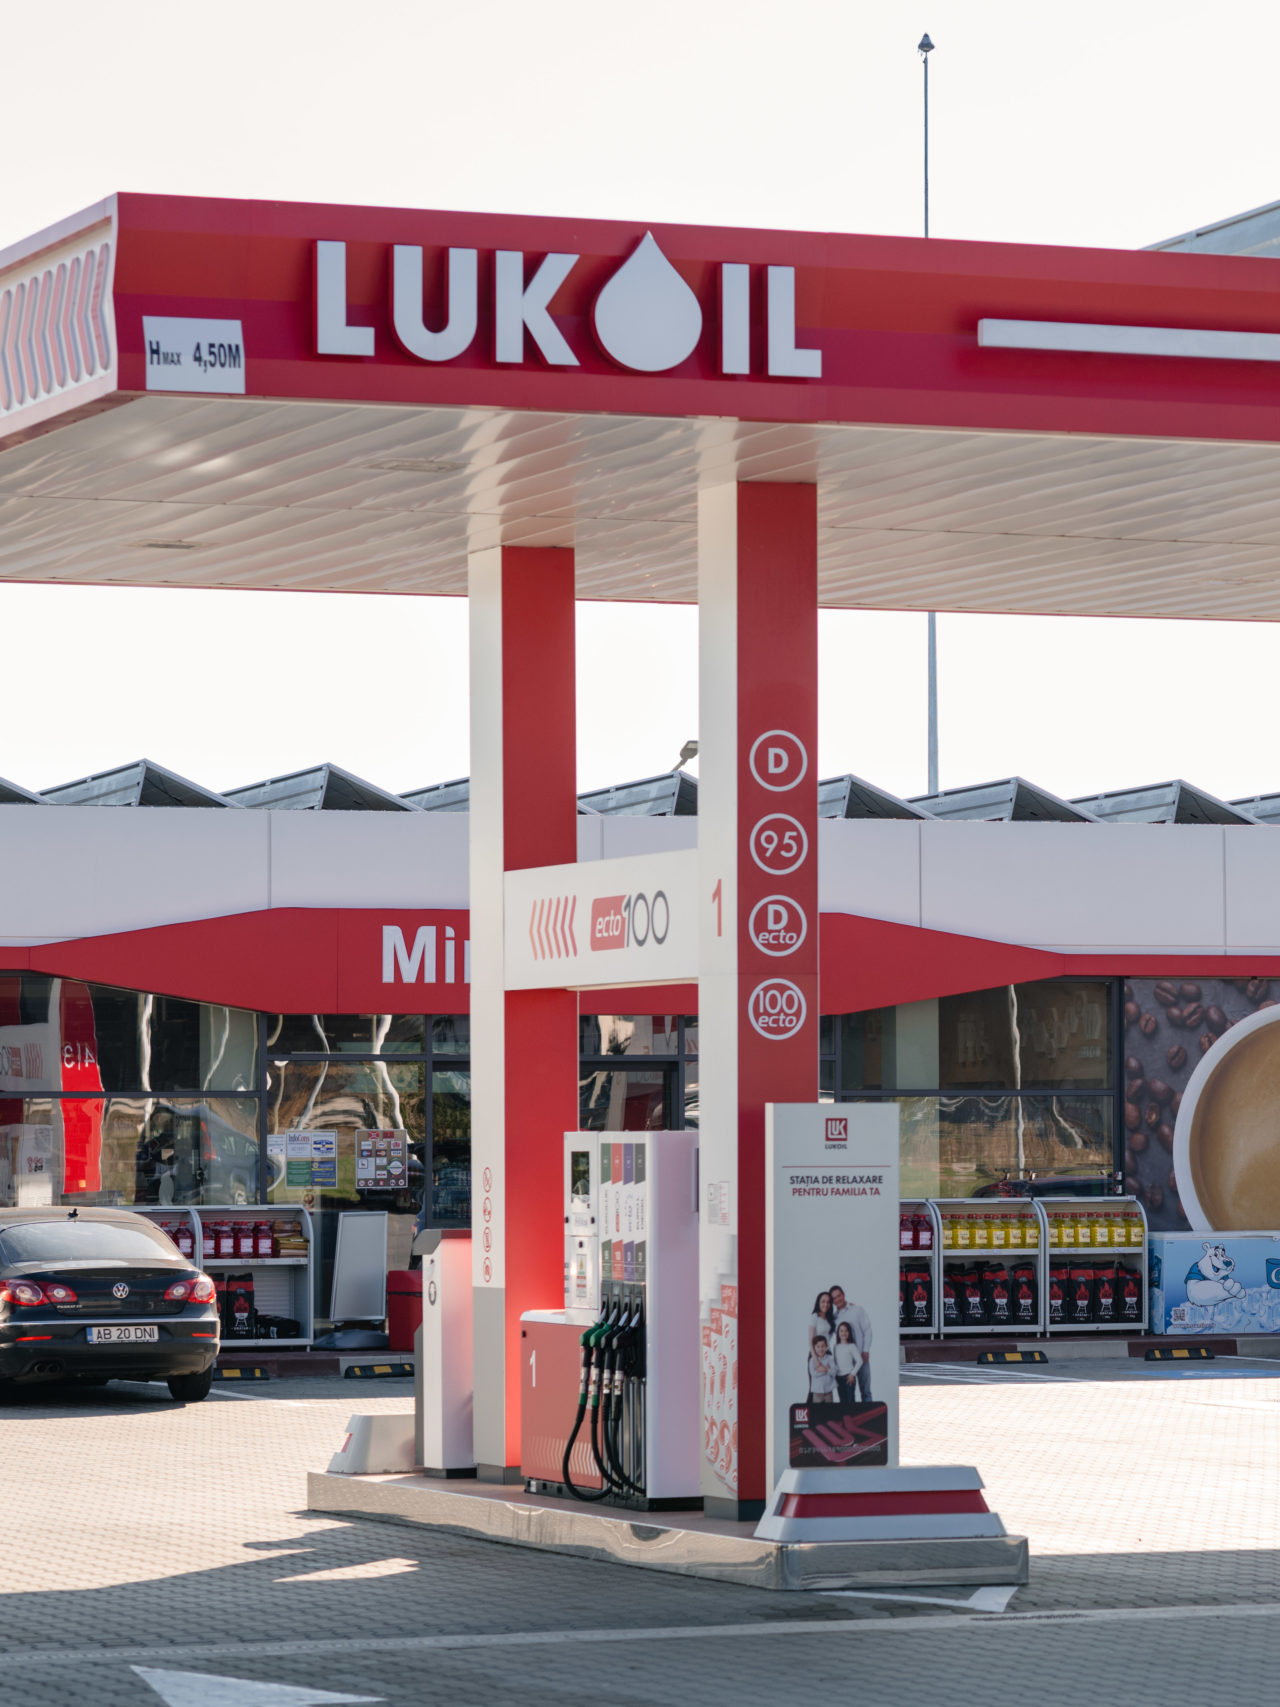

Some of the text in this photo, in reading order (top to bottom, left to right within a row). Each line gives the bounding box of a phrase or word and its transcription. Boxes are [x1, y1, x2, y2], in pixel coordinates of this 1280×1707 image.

[767, 747, 789, 774] D
[760, 830, 798, 858] 95
[595, 890, 670, 947] ecto 100
[712, 878, 723, 938] 1
[767, 904, 789, 931] D
[758, 931, 797, 946] ecto
[758, 990, 798, 1014] 100
[758, 1014, 797, 1029] ecto
[827, 1119, 848, 1139] LUK
[792, 1187, 880, 1196] PENTRU FAMILIA TA
[821, 1175, 833, 1184] DE
[836, 1175, 884, 1184] RELAXARE
[96, 1327, 155, 1340] AB 20 DNI
[529, 1349, 536, 1388] 1
